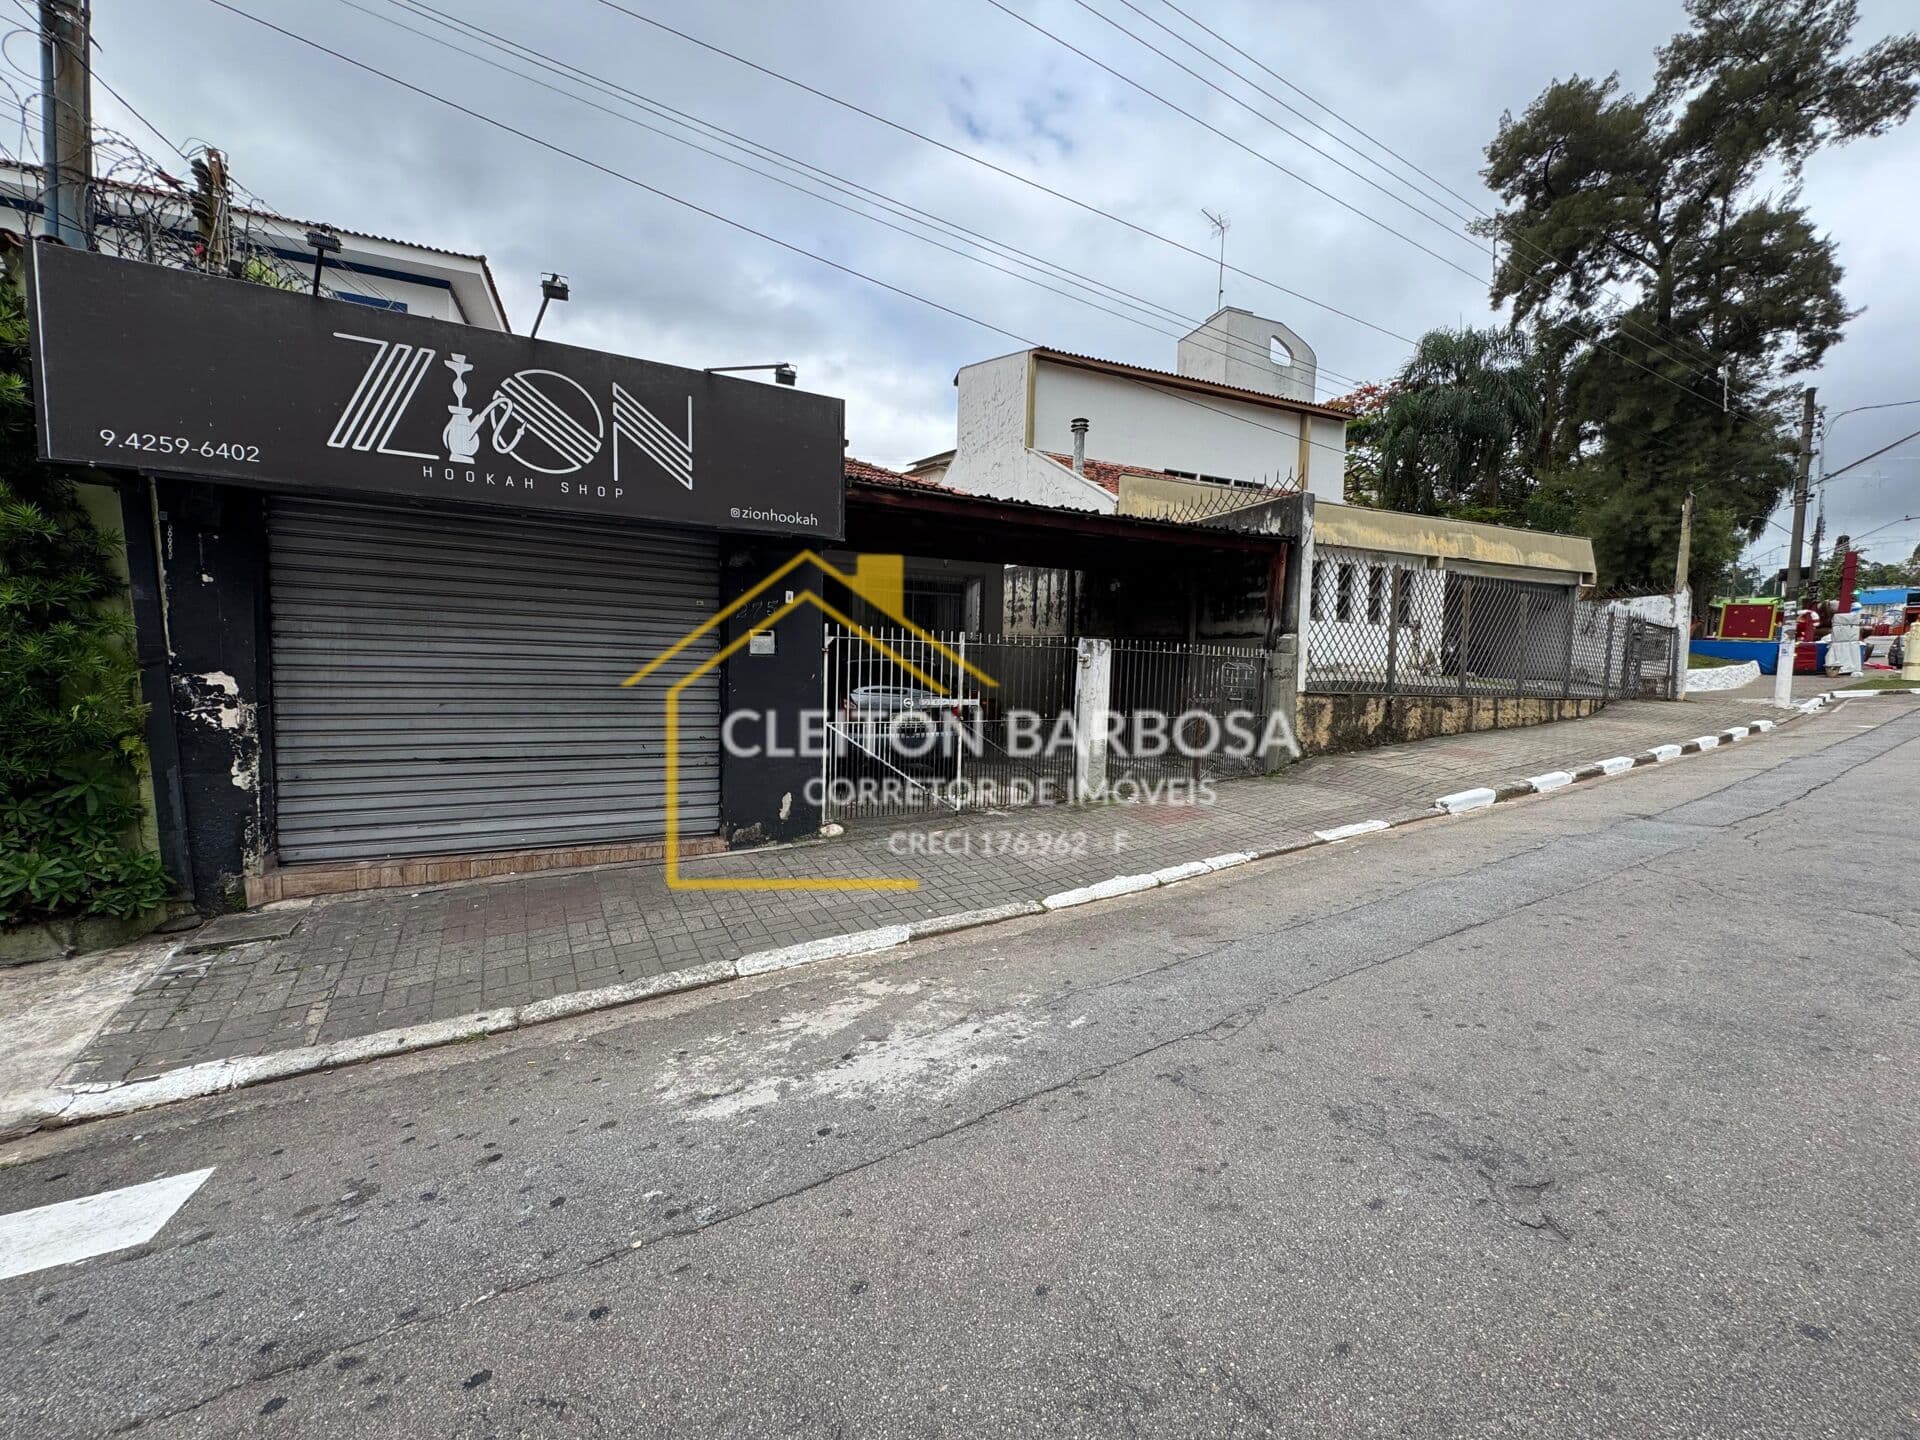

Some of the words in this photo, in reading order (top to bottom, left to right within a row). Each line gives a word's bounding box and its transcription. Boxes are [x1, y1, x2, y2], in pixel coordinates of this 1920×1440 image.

[99, 428, 261, 463] 9.4259-6402
[422, 466, 535, 489] HOOKAH
[560, 481, 625, 499] SHOP
